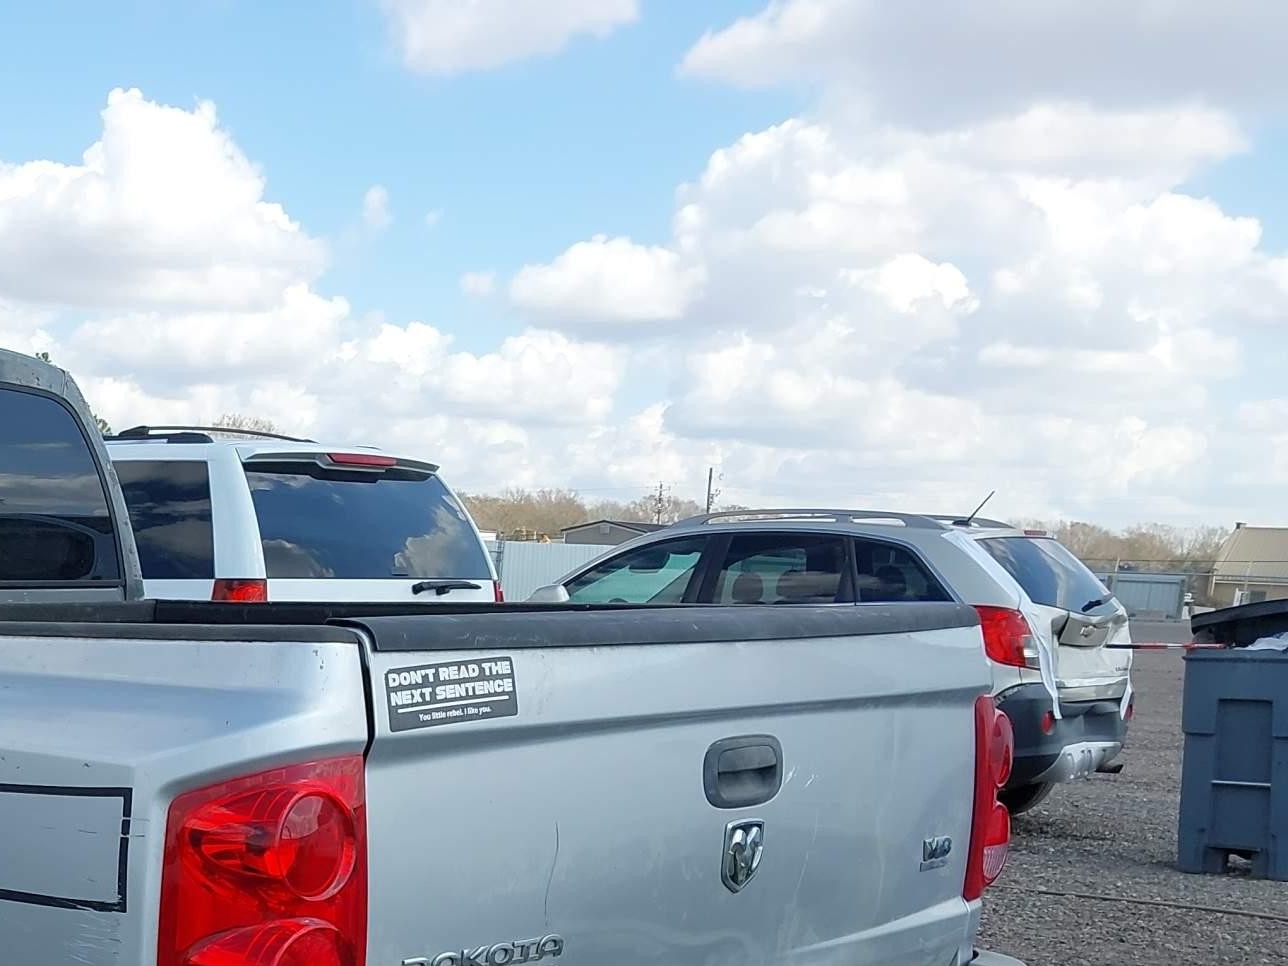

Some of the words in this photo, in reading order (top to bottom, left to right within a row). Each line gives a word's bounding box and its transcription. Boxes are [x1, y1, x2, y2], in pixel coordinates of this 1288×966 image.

[388, 668, 436, 688] DON'T
[438, 664, 480, 680] READ
[482, 661, 512, 676] THE
[390, 687, 432, 706] NEXT
[435, 678, 514, 700] SENTENCE
[419, 713, 432, 721] You
